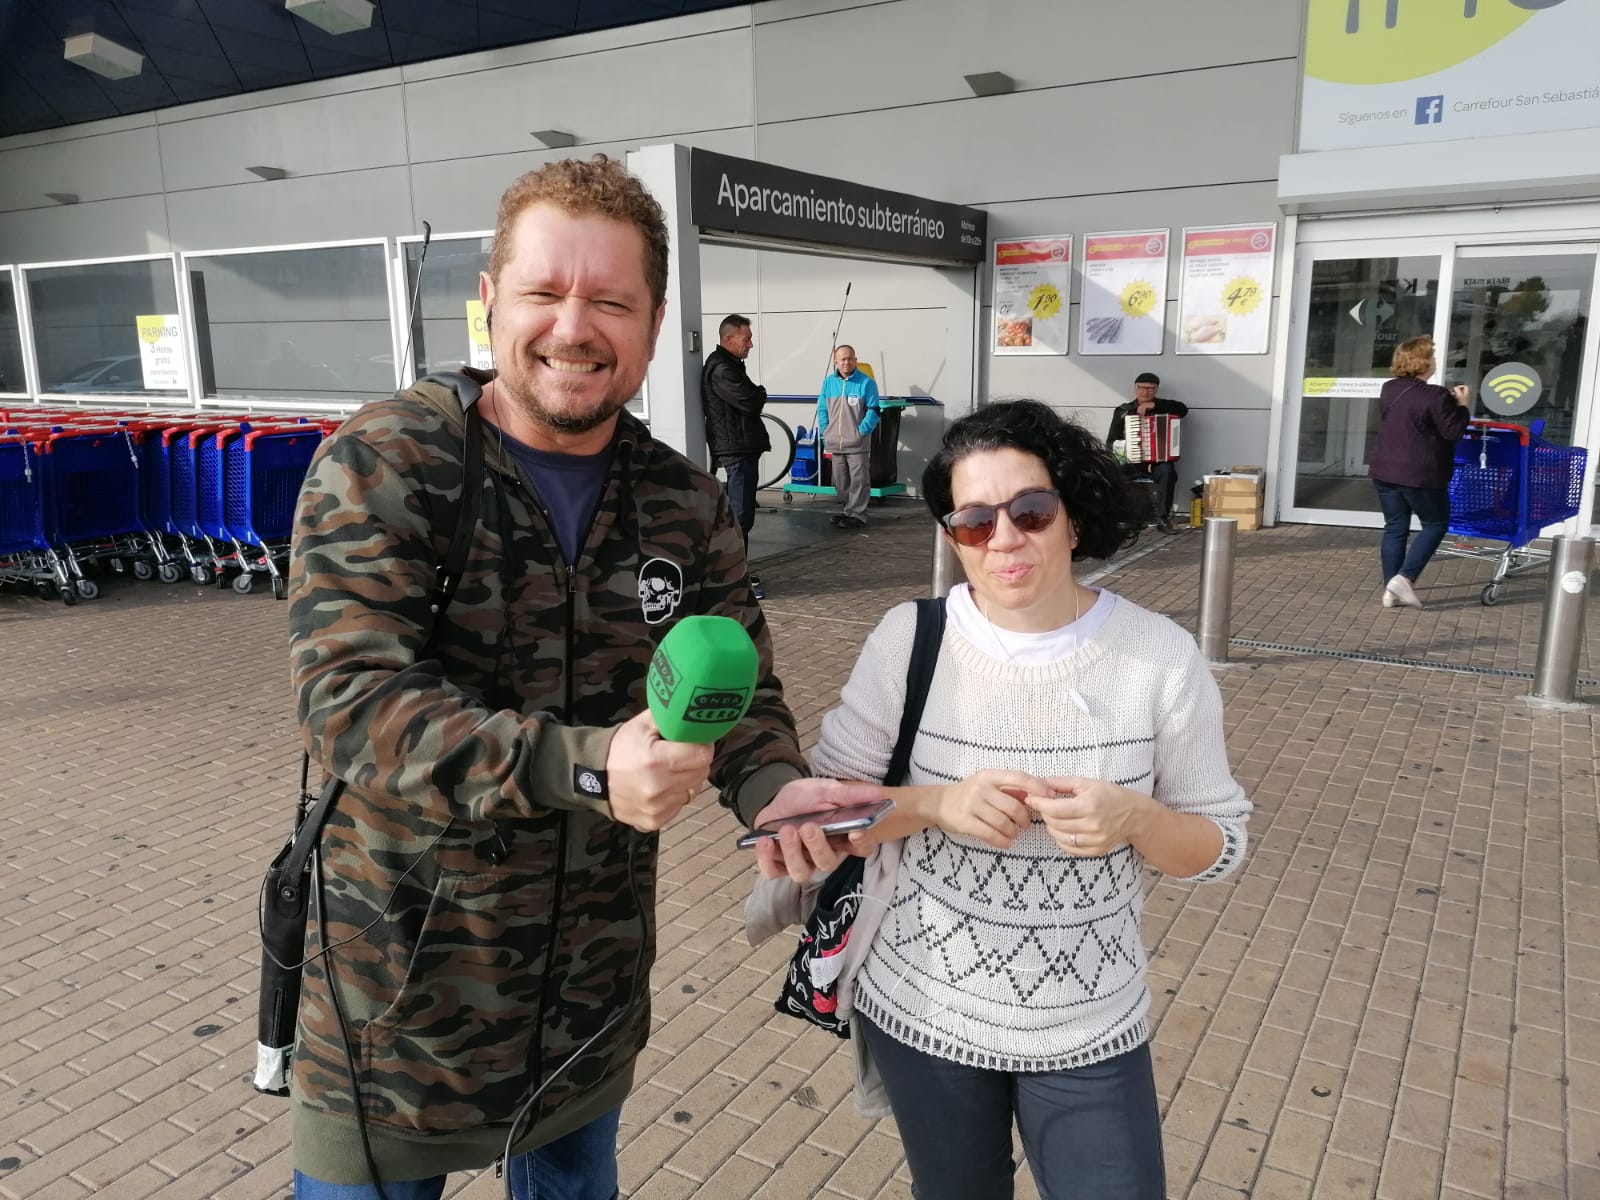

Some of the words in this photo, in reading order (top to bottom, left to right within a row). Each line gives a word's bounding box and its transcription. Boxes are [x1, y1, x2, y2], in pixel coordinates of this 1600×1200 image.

[1453, 97, 1514, 113] Carrefour
[1515, 95, 1540, 107] San
[1338, 110, 1391, 126] Síguenos
[1392, 108, 1408, 119] en
[717, 172, 856, 226] Aparcamiento
[858, 201, 945, 240] subterráneo
[141, 326, 178, 337] PARKING
[150, 342, 156, 353] 3
[699, 697, 739, 705] ONDA
[695, 710, 736, 719] CERO
